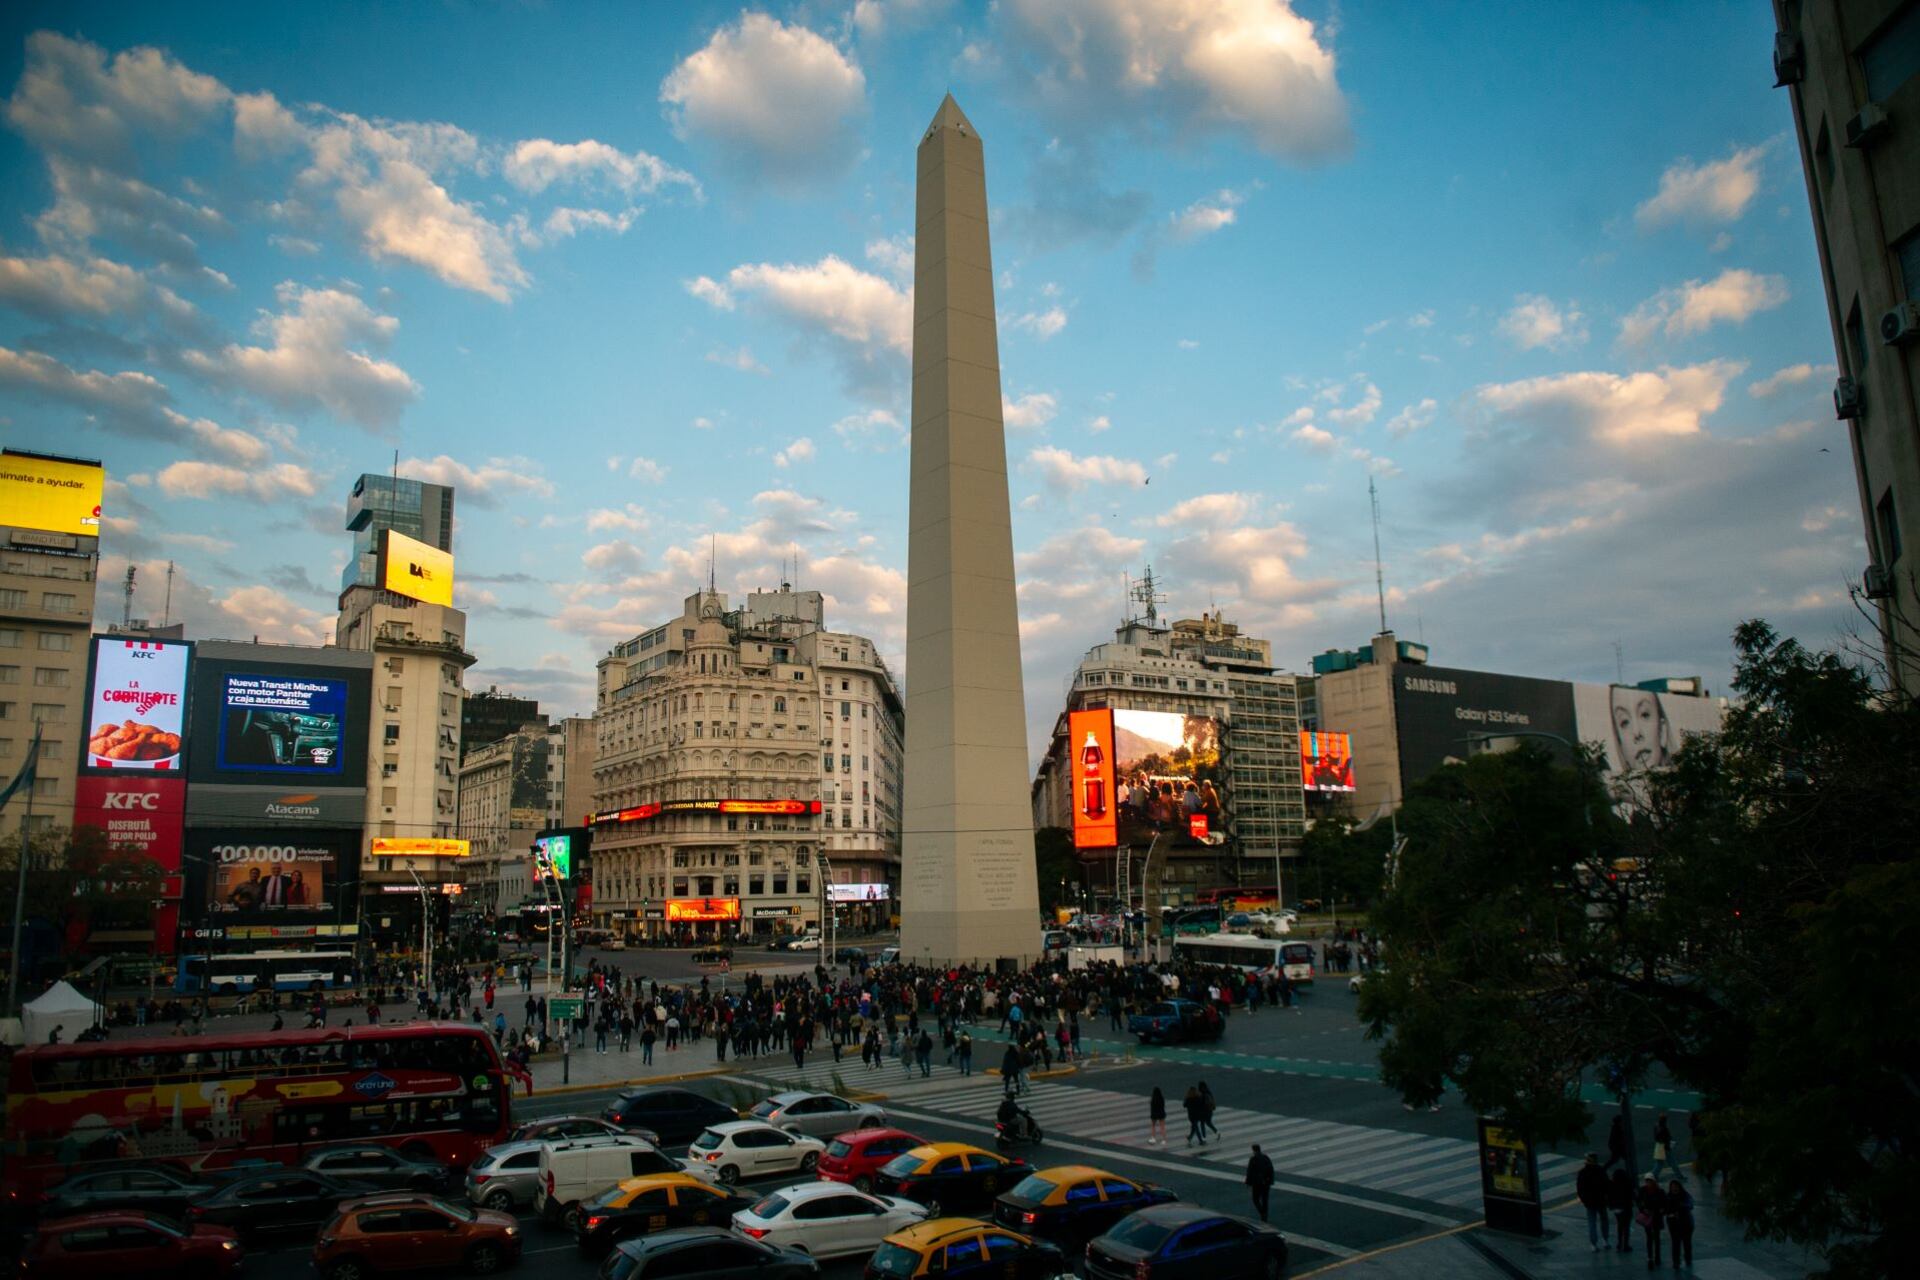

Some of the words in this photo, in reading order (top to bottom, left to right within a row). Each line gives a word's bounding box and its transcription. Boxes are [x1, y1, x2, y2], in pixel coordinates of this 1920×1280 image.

[46, 478, 85, 489] ayudar.
[132, 651, 156, 659] KFC
[229, 679, 259, 688] Nueva
[260, 680, 292, 689] Transit
[293, 683, 329, 692] Minibus
[1404, 677, 1457, 695] SAMSUNG
[247, 688, 275, 696] motor
[276, 690, 313, 698] Panther
[235, 696, 254, 704] caja
[255, 697, 310, 706] automática.
[1455, 707, 1487, 724] Galaxy
[1504, 712, 1530, 725] Series
[102, 792, 160, 810] KFC
[265, 803, 320, 814] Atacama
[108, 818, 151, 831] DISFRUTÁ
[134, 832, 157, 840] POLLO
[212, 845, 297, 863] 100.000
